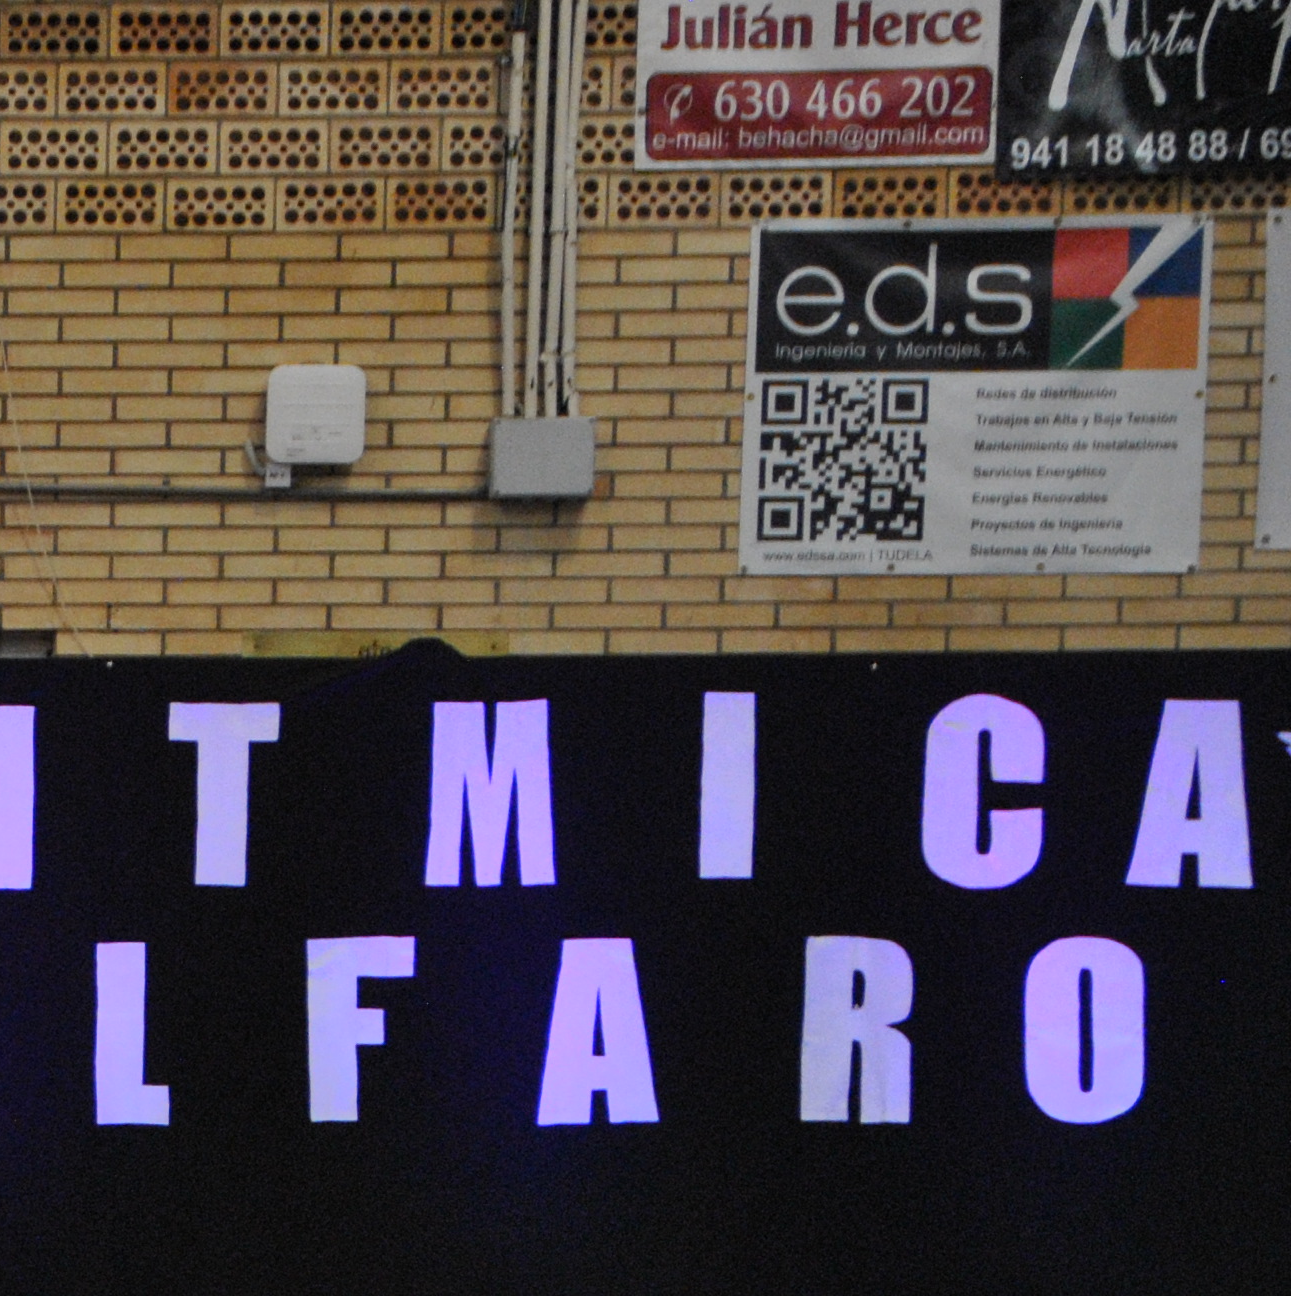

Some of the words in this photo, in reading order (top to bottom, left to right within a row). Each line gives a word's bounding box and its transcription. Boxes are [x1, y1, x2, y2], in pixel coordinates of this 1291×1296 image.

[660, 3, 814, 51] Julián
[833, 0, 983, 48] Herce
[713, 79, 791, 123] 630
[805, 77, 883, 121] 466
[899, 74, 977, 120] 202
[651, 128, 729, 151] e-mail:
[738, 123, 985, 153] behacha@gmail.com
[1011, 135, 1069, 171] 941
[1086, 132, 1125, 167] 18
[1134, 130, 1177, 165] 48
[1188, 128, 1229, 162] 88
[775, 241, 1034, 337] e.d.s
[875, 344, 888, 362] y
[1020, 386, 1037, 400] de
[1033, 415, 1051, 426] en
[1082, 414, 1090, 429] y
[1071, 439, 1089, 452] de
[1039, 517, 1056, 530] de
[1032, 543, 1048, 557] de
